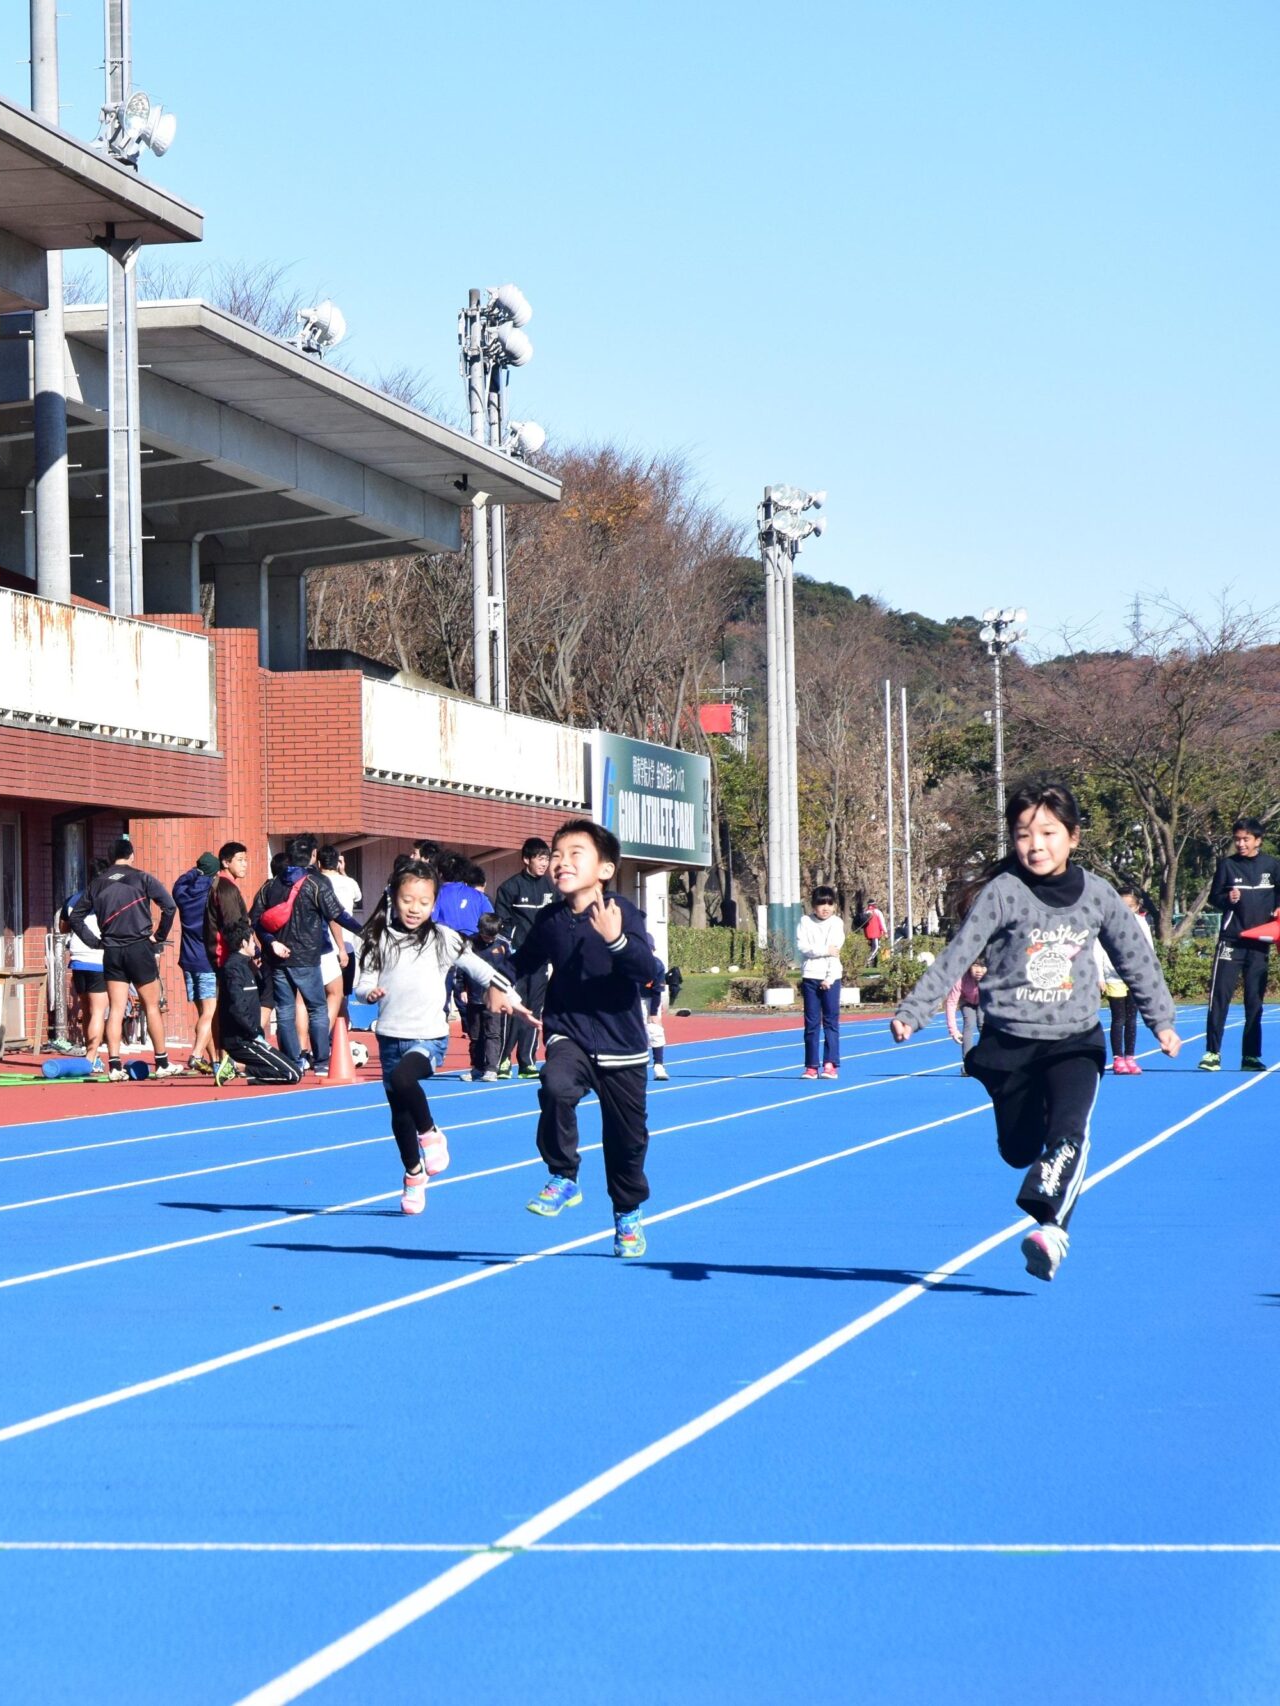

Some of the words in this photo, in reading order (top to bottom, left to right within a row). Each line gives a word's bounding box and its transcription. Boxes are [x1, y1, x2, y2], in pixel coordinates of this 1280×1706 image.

[619, 789, 640, 844] GION
[641, 794, 674, 848] ATHLETE
[674, 800, 695, 850] PARK
[1028, 924, 1089, 946] Restful
[1016, 987, 1073, 1003] VIVACITY
